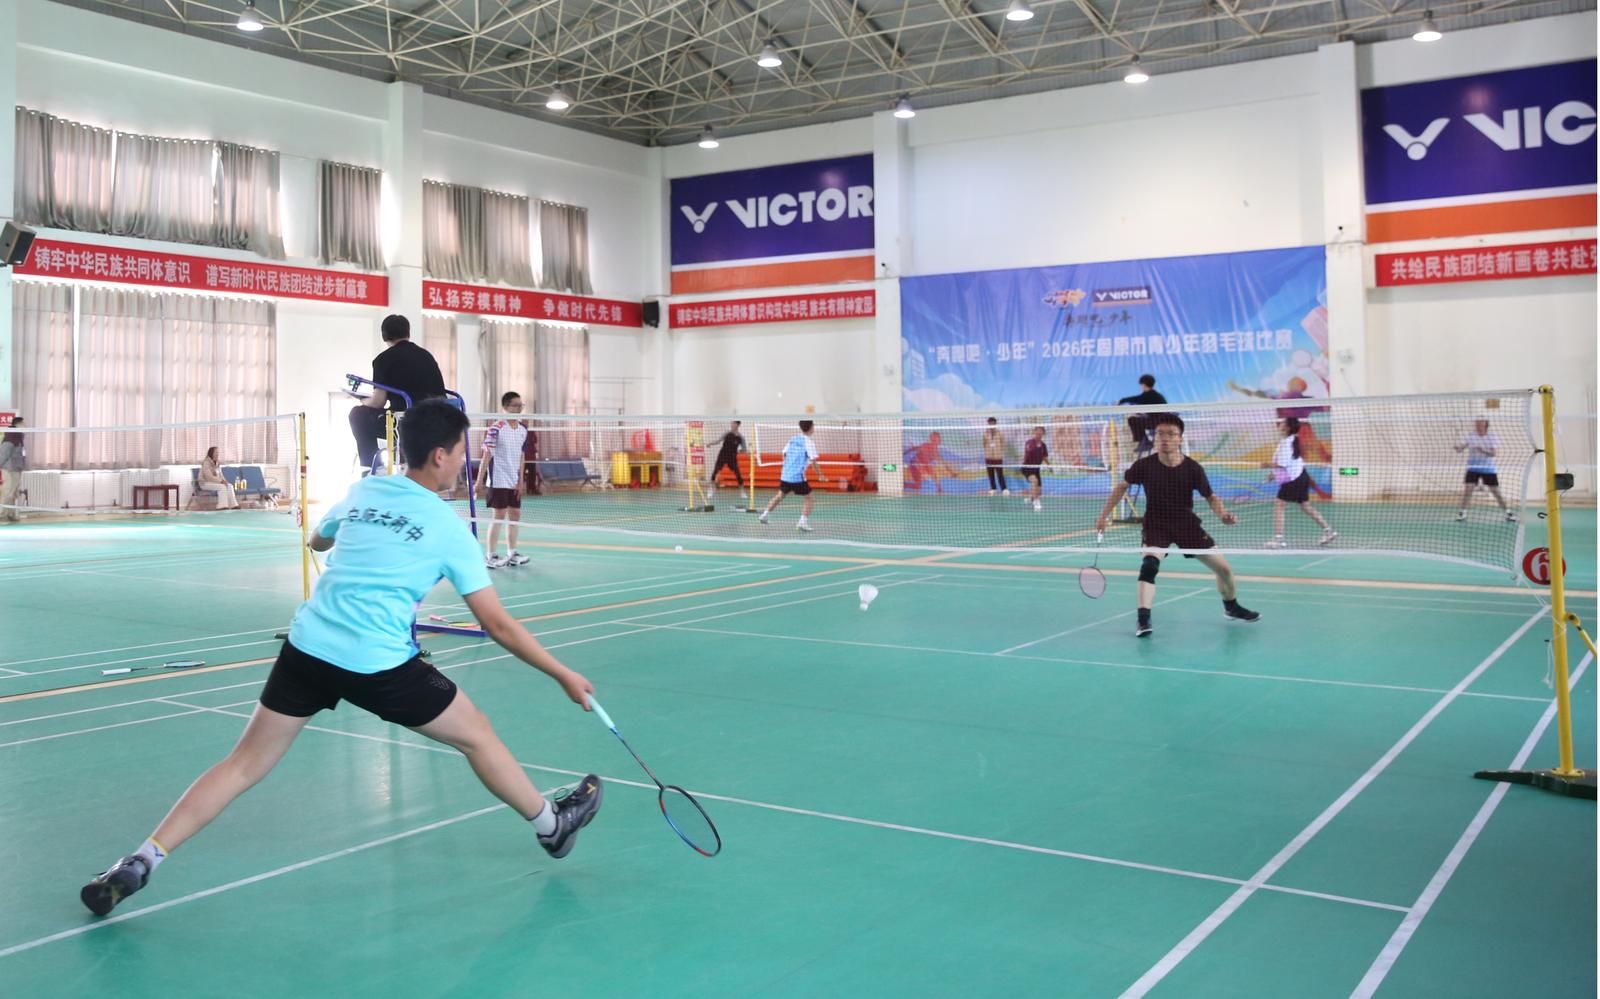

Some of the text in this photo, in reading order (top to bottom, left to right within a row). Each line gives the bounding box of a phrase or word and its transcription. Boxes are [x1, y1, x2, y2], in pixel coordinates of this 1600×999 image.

[1463, 100, 1597, 151] VIC
[725, 185, 874, 228] VICTOR
[34, 245, 368, 300] 铸牢中华民族共同体意识 谱写新时代民族团结进步新篇章
[428, 286, 623, 322] 弘扬劳模精神 争做时代先锋
[1109, 289, 1149, 301] VICTOR
[1042, 329, 1294, 358] 2026年固原市青少年羽毛球比赛
